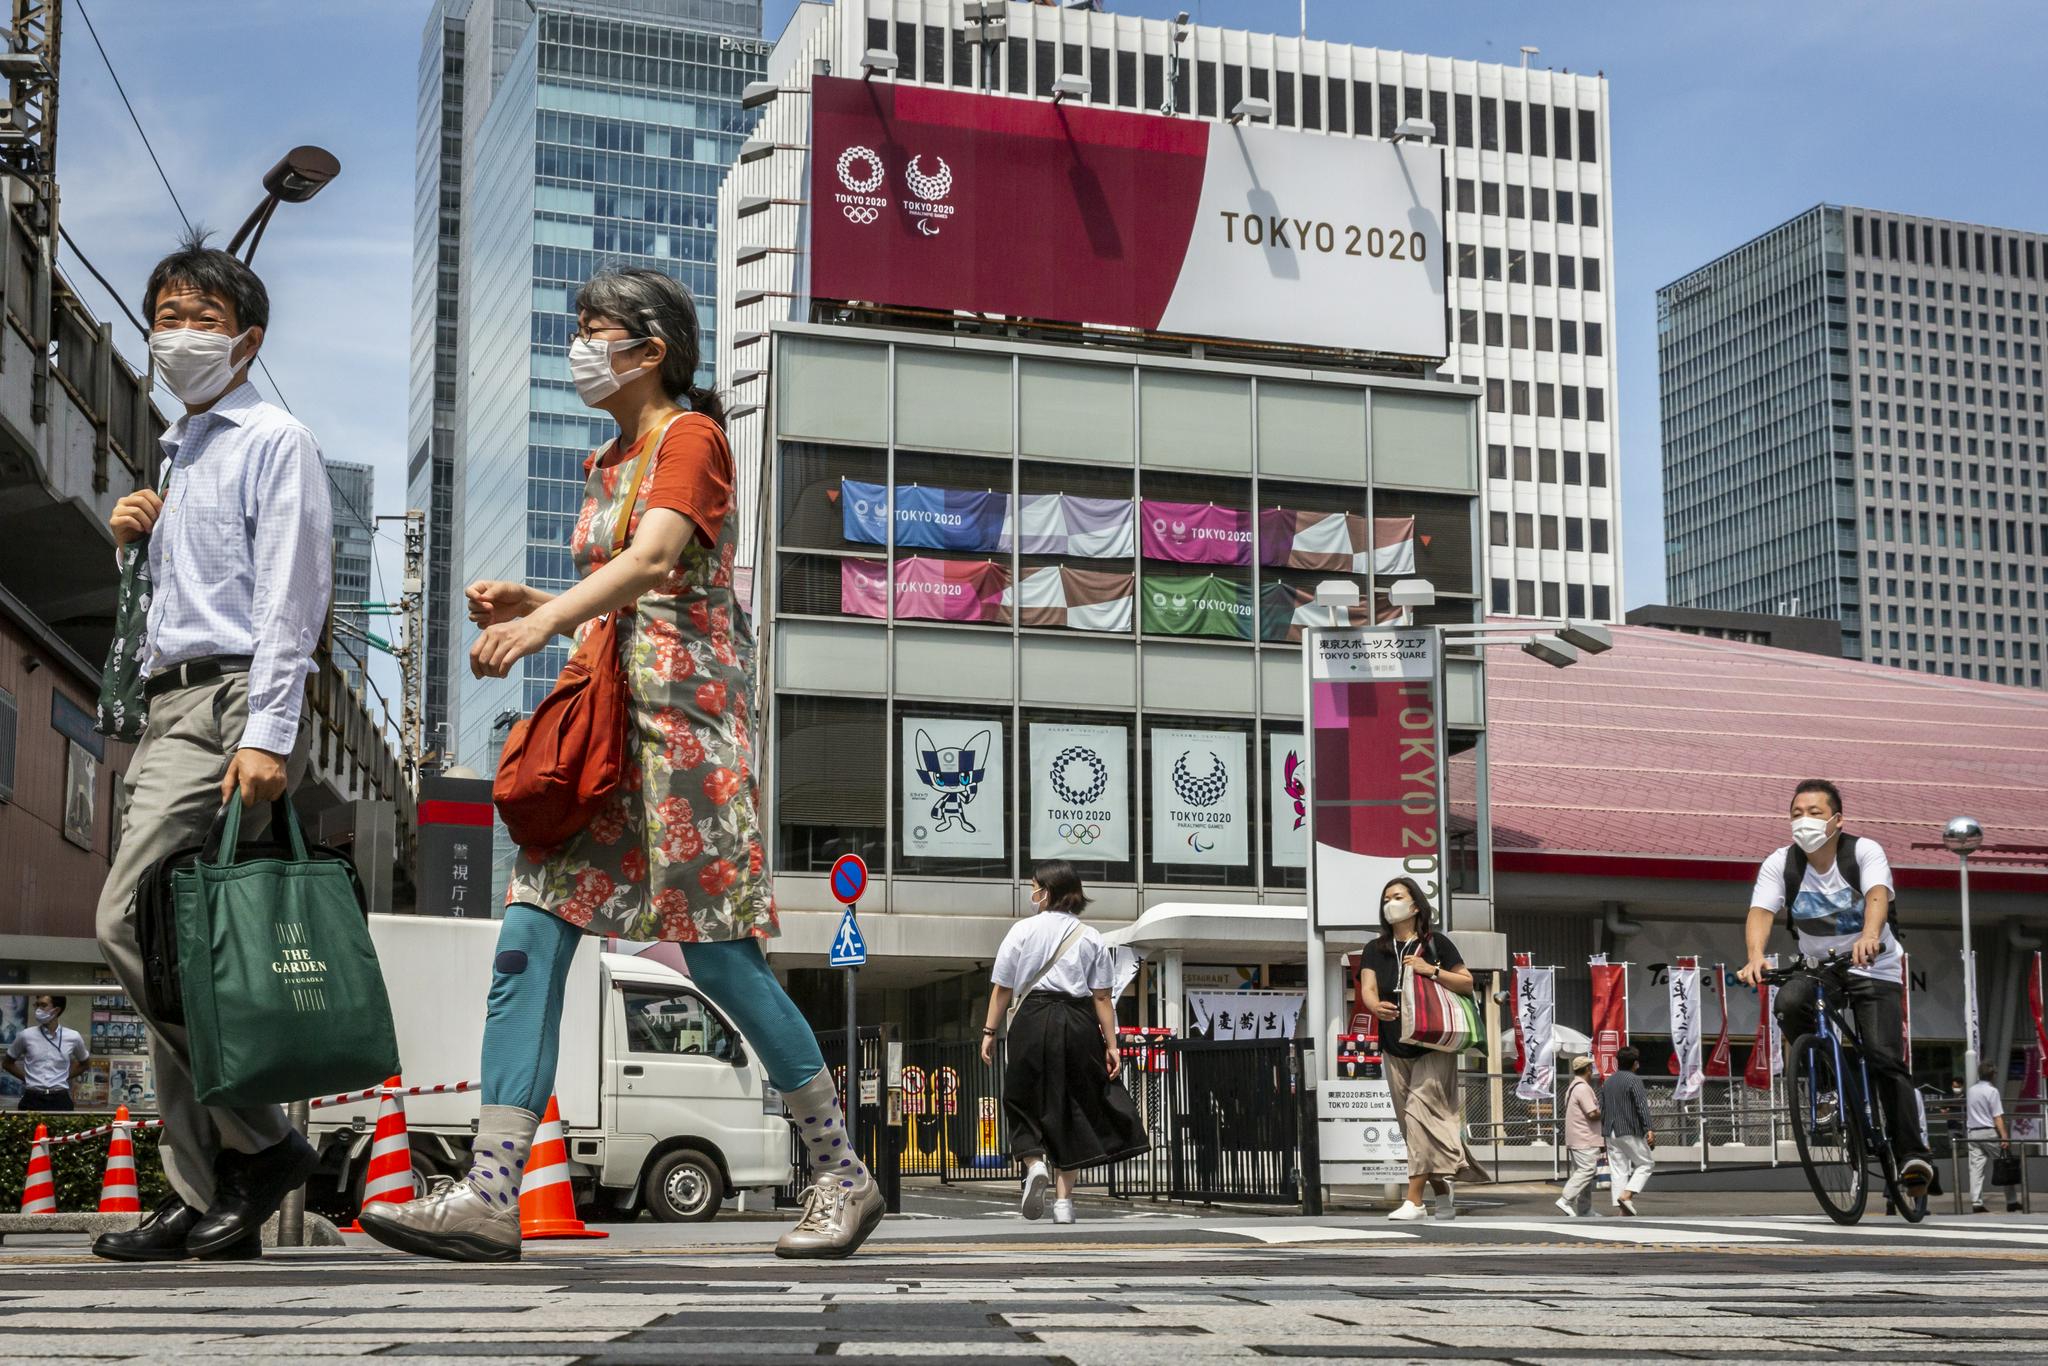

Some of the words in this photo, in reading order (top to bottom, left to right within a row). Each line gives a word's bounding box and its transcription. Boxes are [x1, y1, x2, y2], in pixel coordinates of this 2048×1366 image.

[835, 193, 864, 205] TOKYO
[865, 197, 887, 207] 2020
[903, 200, 932, 212] TOKYO
[932, 205, 954, 214] 2020
[1220, 211, 1334, 252] TOKYO
[1345, 224, 1427, 262] 2020
[895, 510, 932, 522] TOKYO
[934, 513, 962, 525] 2020
[1191, 528, 1226, 540] TOKYO
[895, 582, 932, 593] TOKYO
[934, 583, 962, 595] 2020
[1192, 599, 1226, 611] TOKYO
[1227, 603, 1252, 616] 2020
[1319, 638, 1426, 649] 東京スポーツスクエア
[1320, 652, 1350, 660] TOKYO
[1352, 651, 1388, 659] SPORTS
[1390, 651, 1427, 660] SQUARE
[1398, 681, 1437, 815] TOKYO
[1048, 809, 1083, 820] TOKYO
[1085, 810, 1111, 821] 2020
[1170, 811, 1204, 822] TOKYO
[1206, 812, 1231, 823] 2020
[282, 949, 311, 961] THE
[272, 960, 328, 973] GARDEN
[1328, 1101, 1350, 1109] TOKYO
[1351, 1101, 1368, 1109] 2020
[1370, 1101, 1384, 1109] Lost
